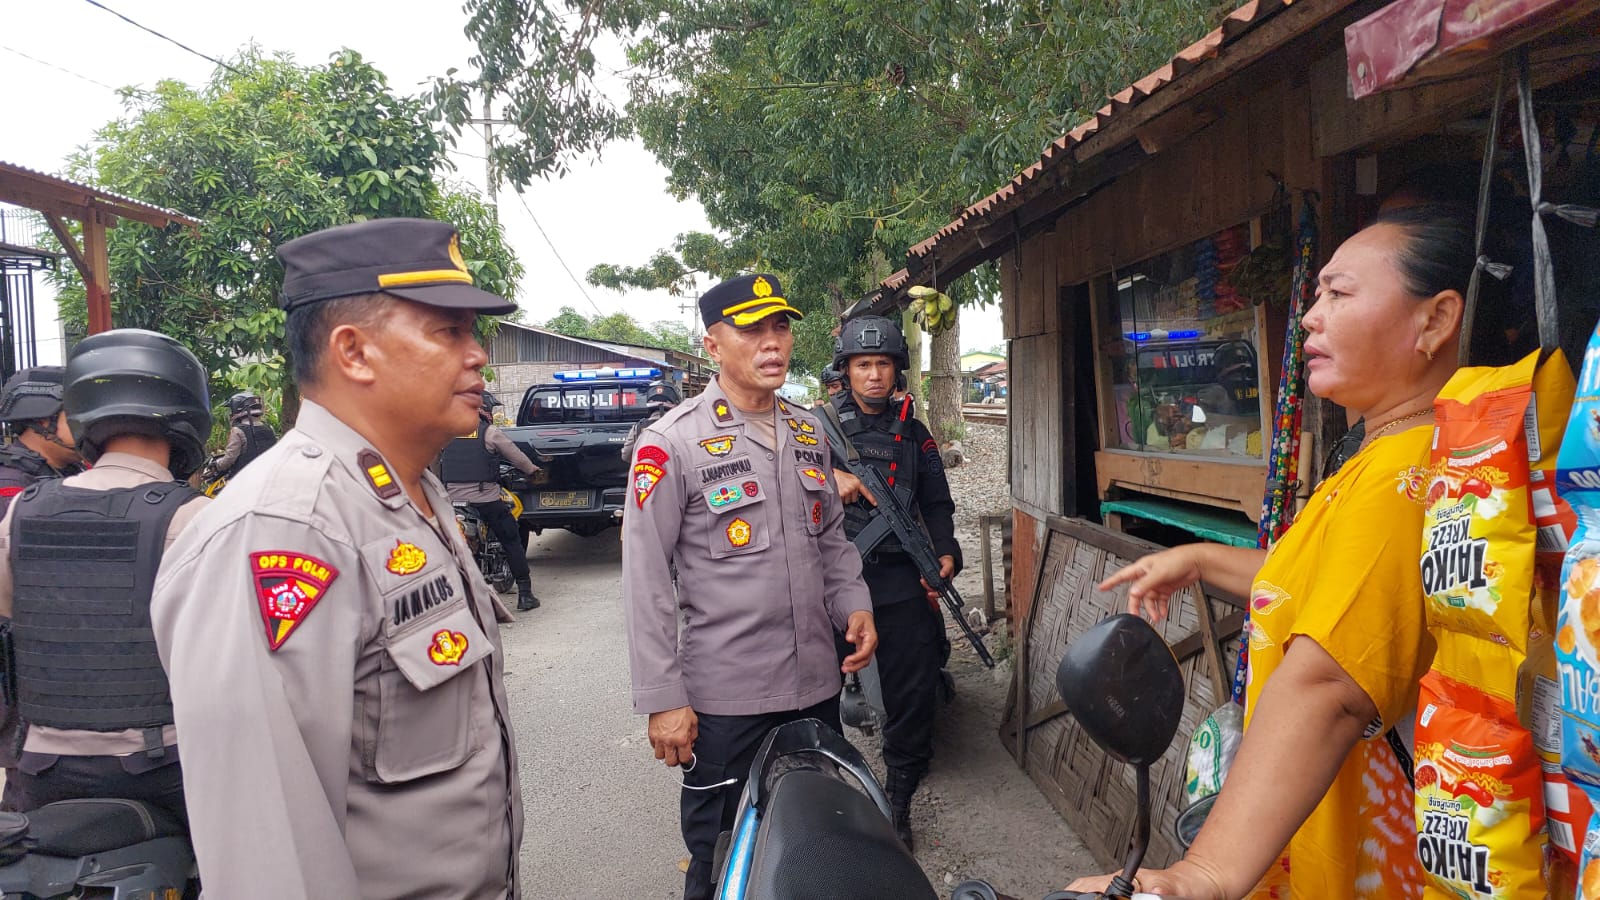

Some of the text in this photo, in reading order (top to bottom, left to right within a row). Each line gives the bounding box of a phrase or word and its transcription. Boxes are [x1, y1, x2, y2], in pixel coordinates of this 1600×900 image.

[547, 393, 613, 408] PATROLI
[1431, 518, 1470, 550] KREZZ
[259, 555, 330, 582] OPS POLRI
[393, 574, 454, 626] JAMALUS
[1425, 815, 1468, 841] KREZZ
